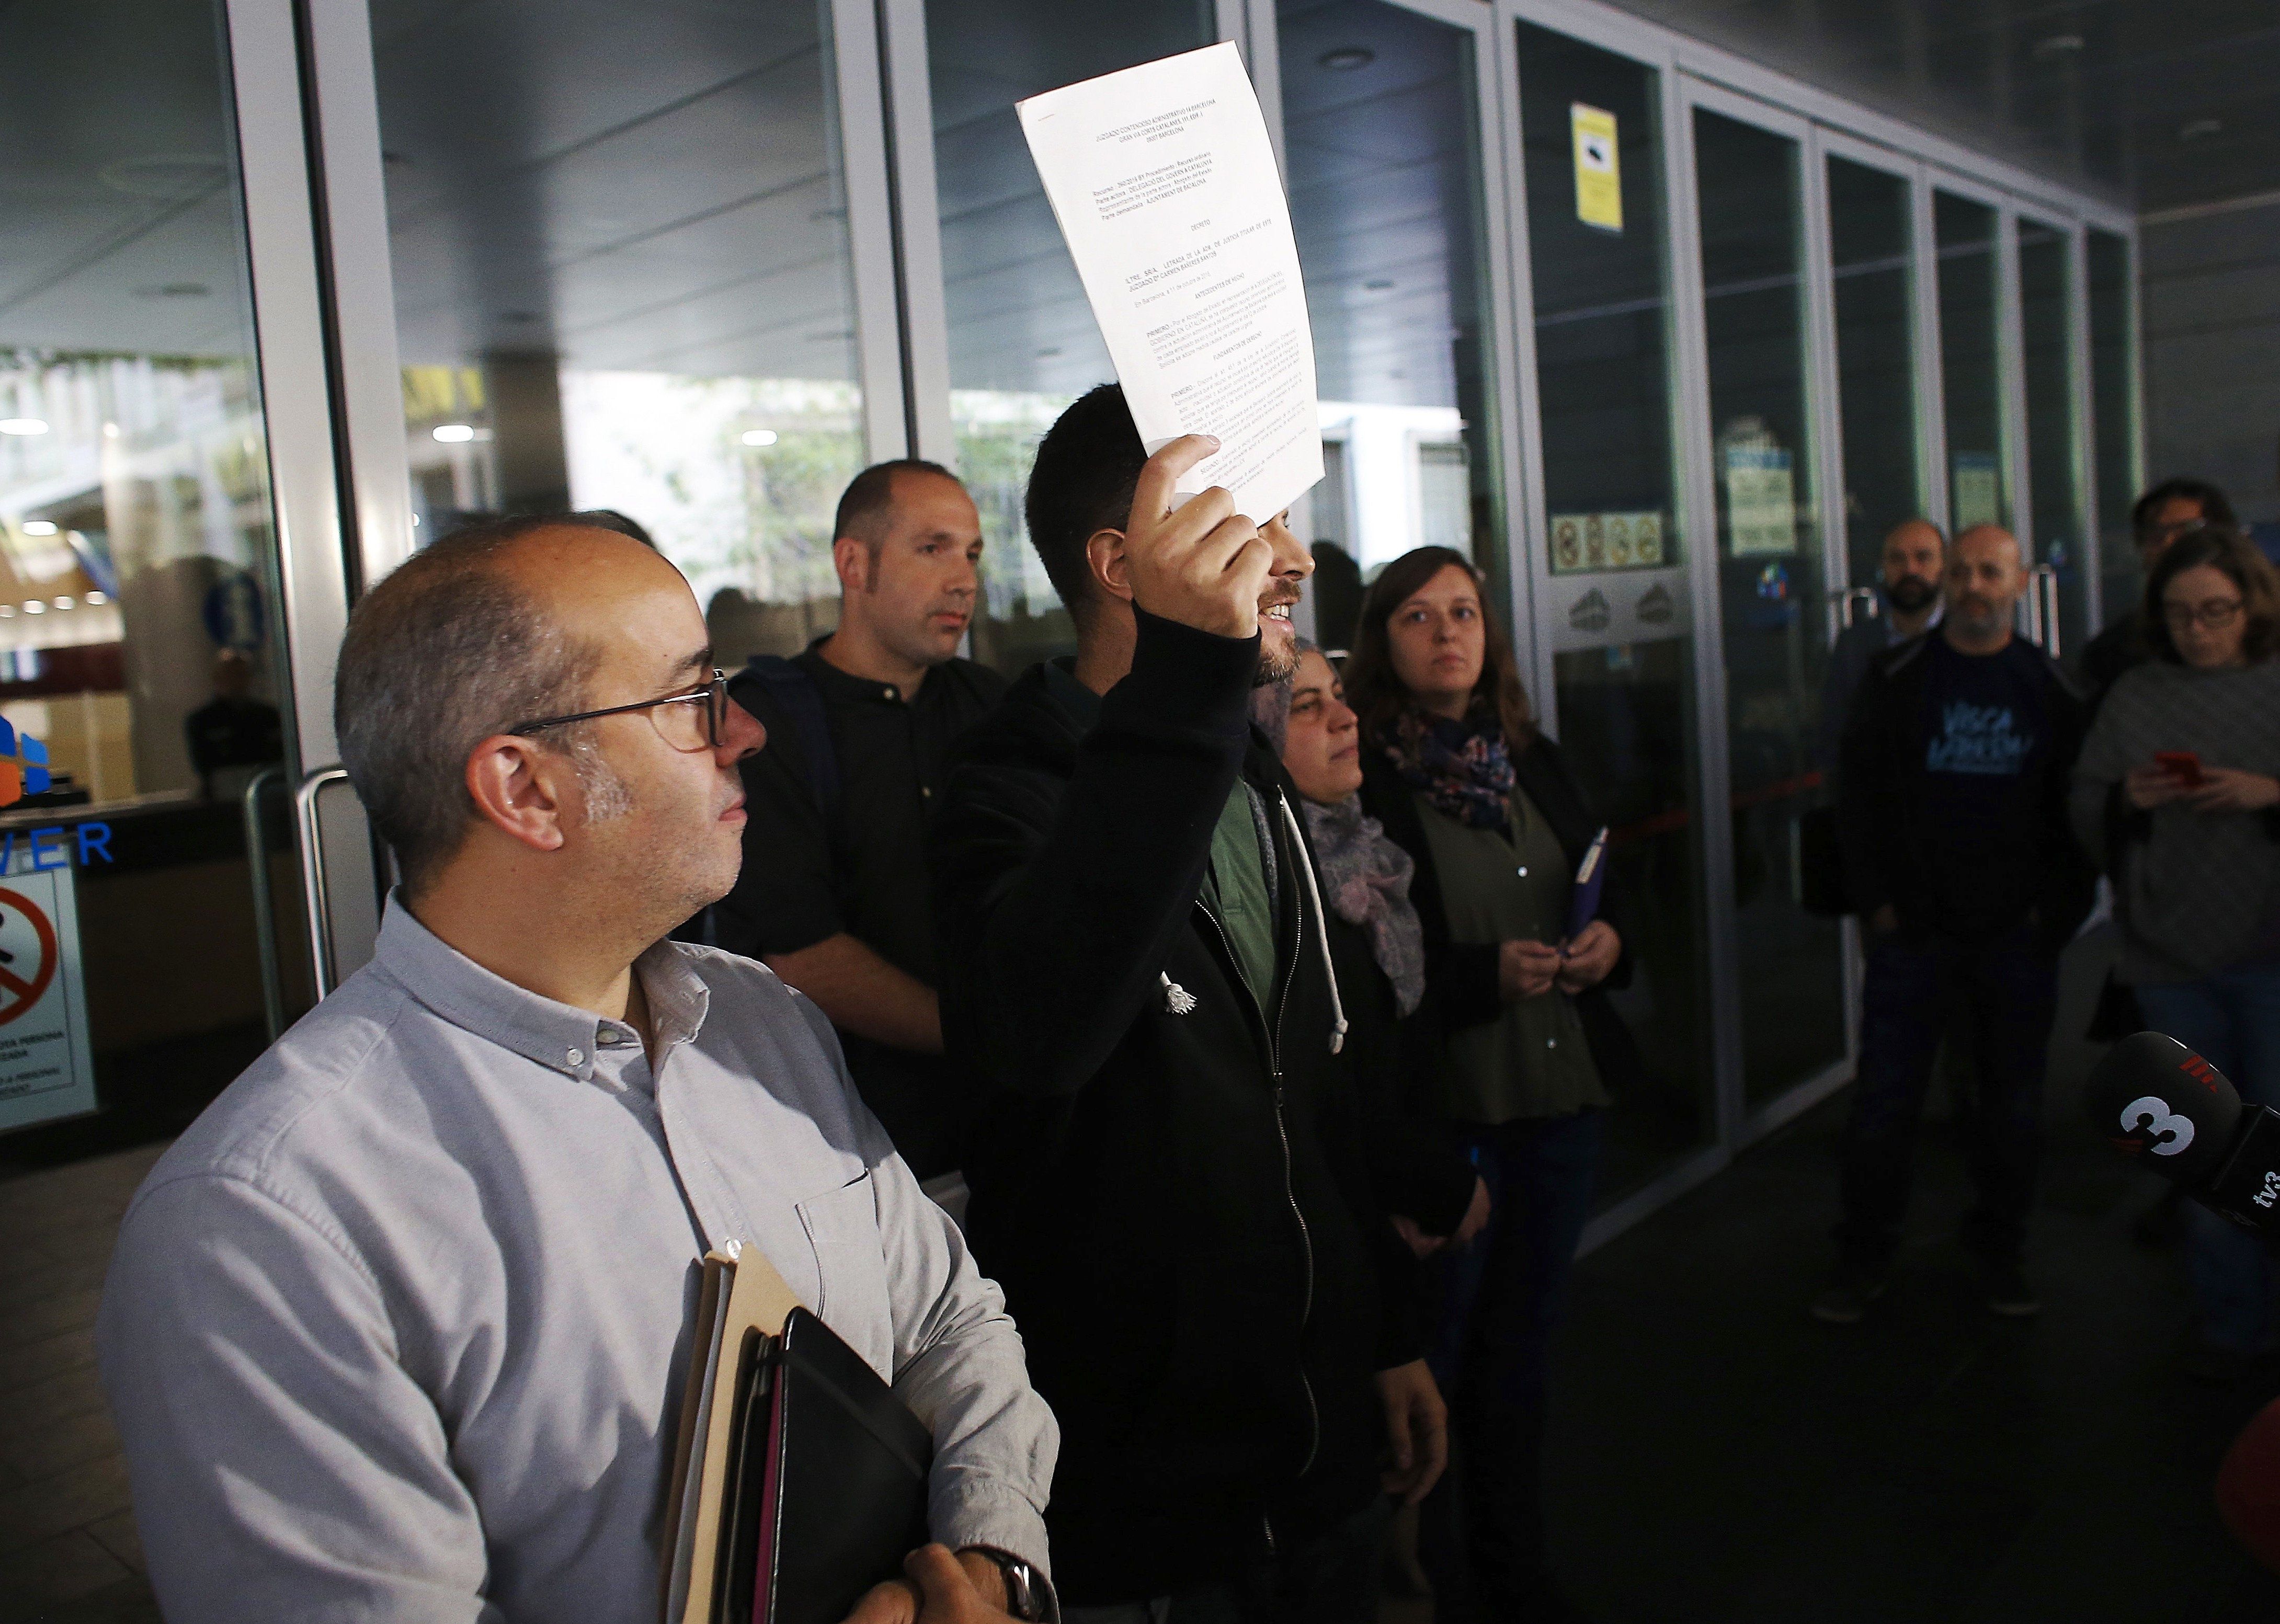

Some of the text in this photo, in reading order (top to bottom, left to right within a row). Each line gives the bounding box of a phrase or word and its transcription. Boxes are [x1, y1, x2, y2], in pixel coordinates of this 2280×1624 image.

[1188, 159, 1212, 171] CATALUNYA
[2120, 1096, 2194, 1156] 3
[2253, 1171, 2280, 1208] tv3
